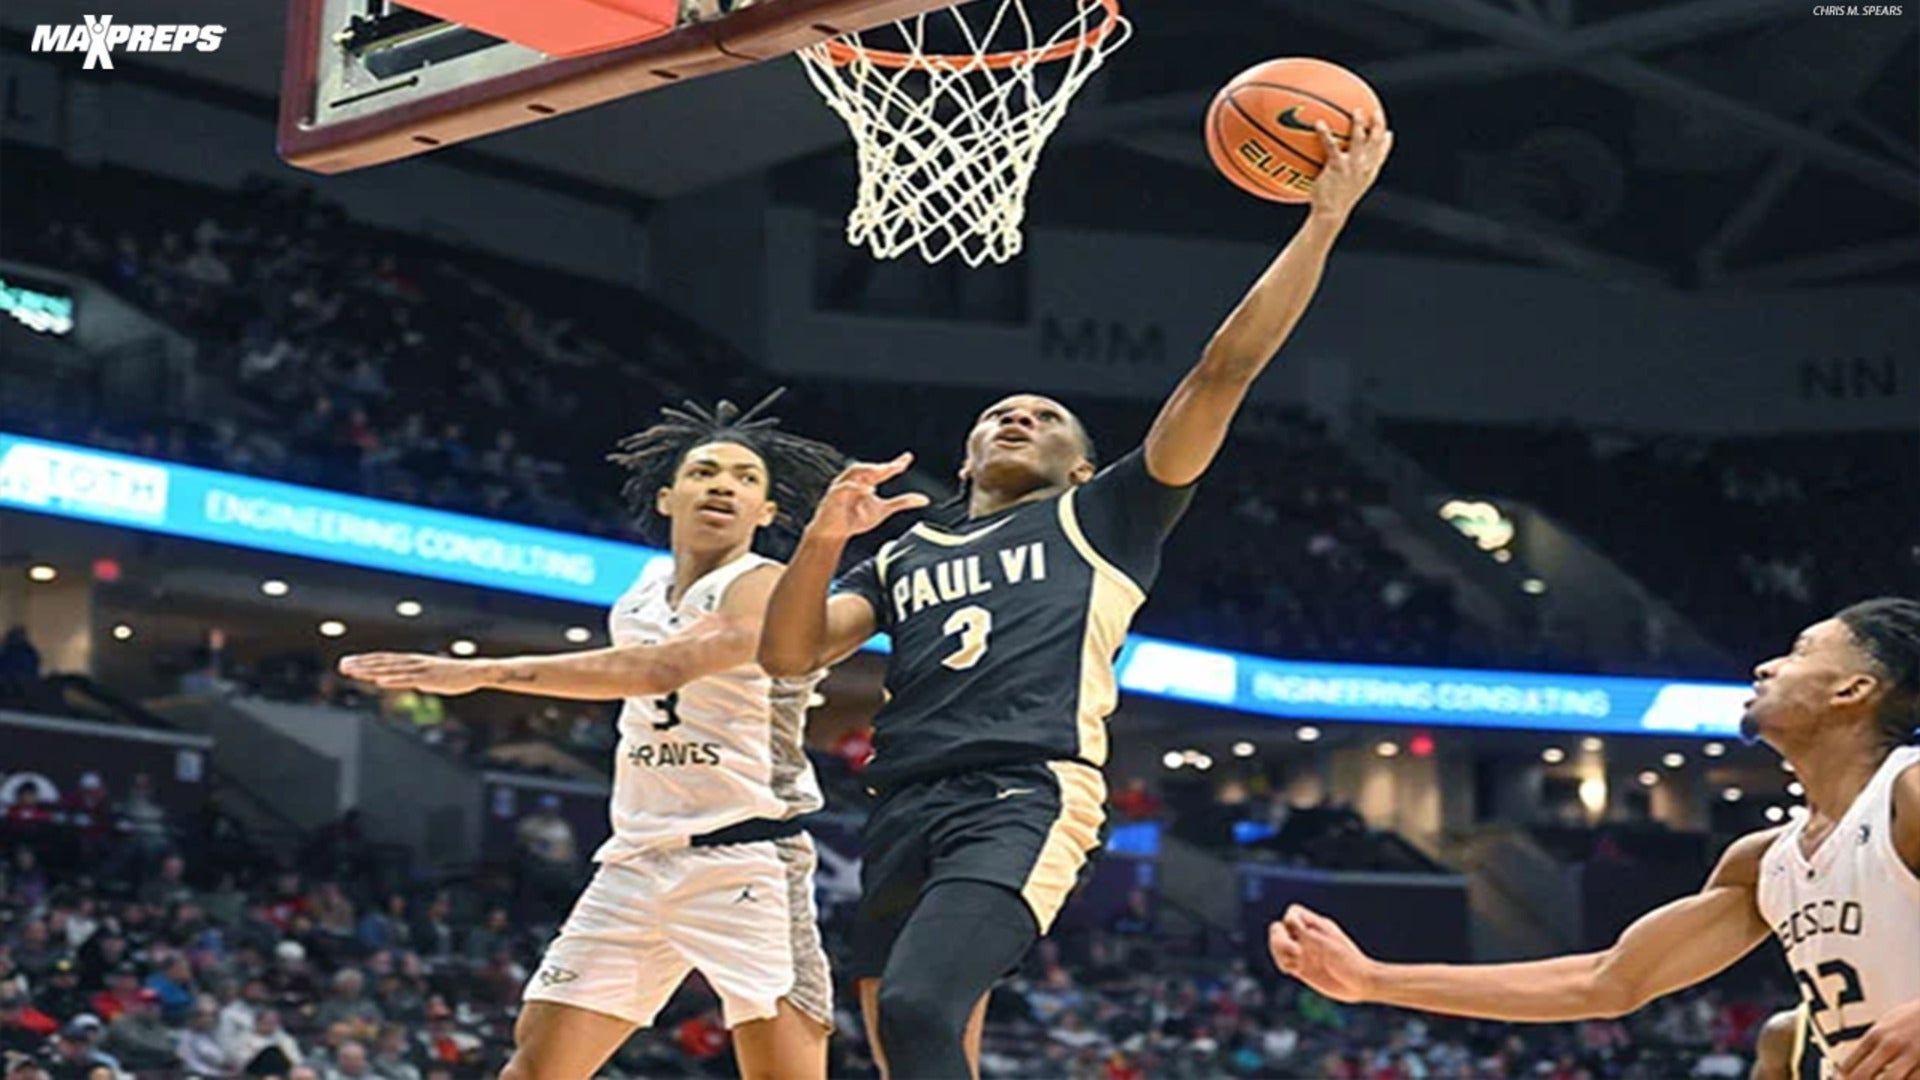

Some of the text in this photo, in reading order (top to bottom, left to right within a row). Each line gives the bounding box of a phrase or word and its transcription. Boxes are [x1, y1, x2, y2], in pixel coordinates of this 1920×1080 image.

[1041, 316, 1166, 365] MM
[1797, 355, 1897, 400] NN
[204, 488, 412, 555] ENGINEERING
[415, 527, 596, 586] CONSULTING
[892, 541, 1046, 623] PAUL VI
[940, 604, 993, 671] 3
